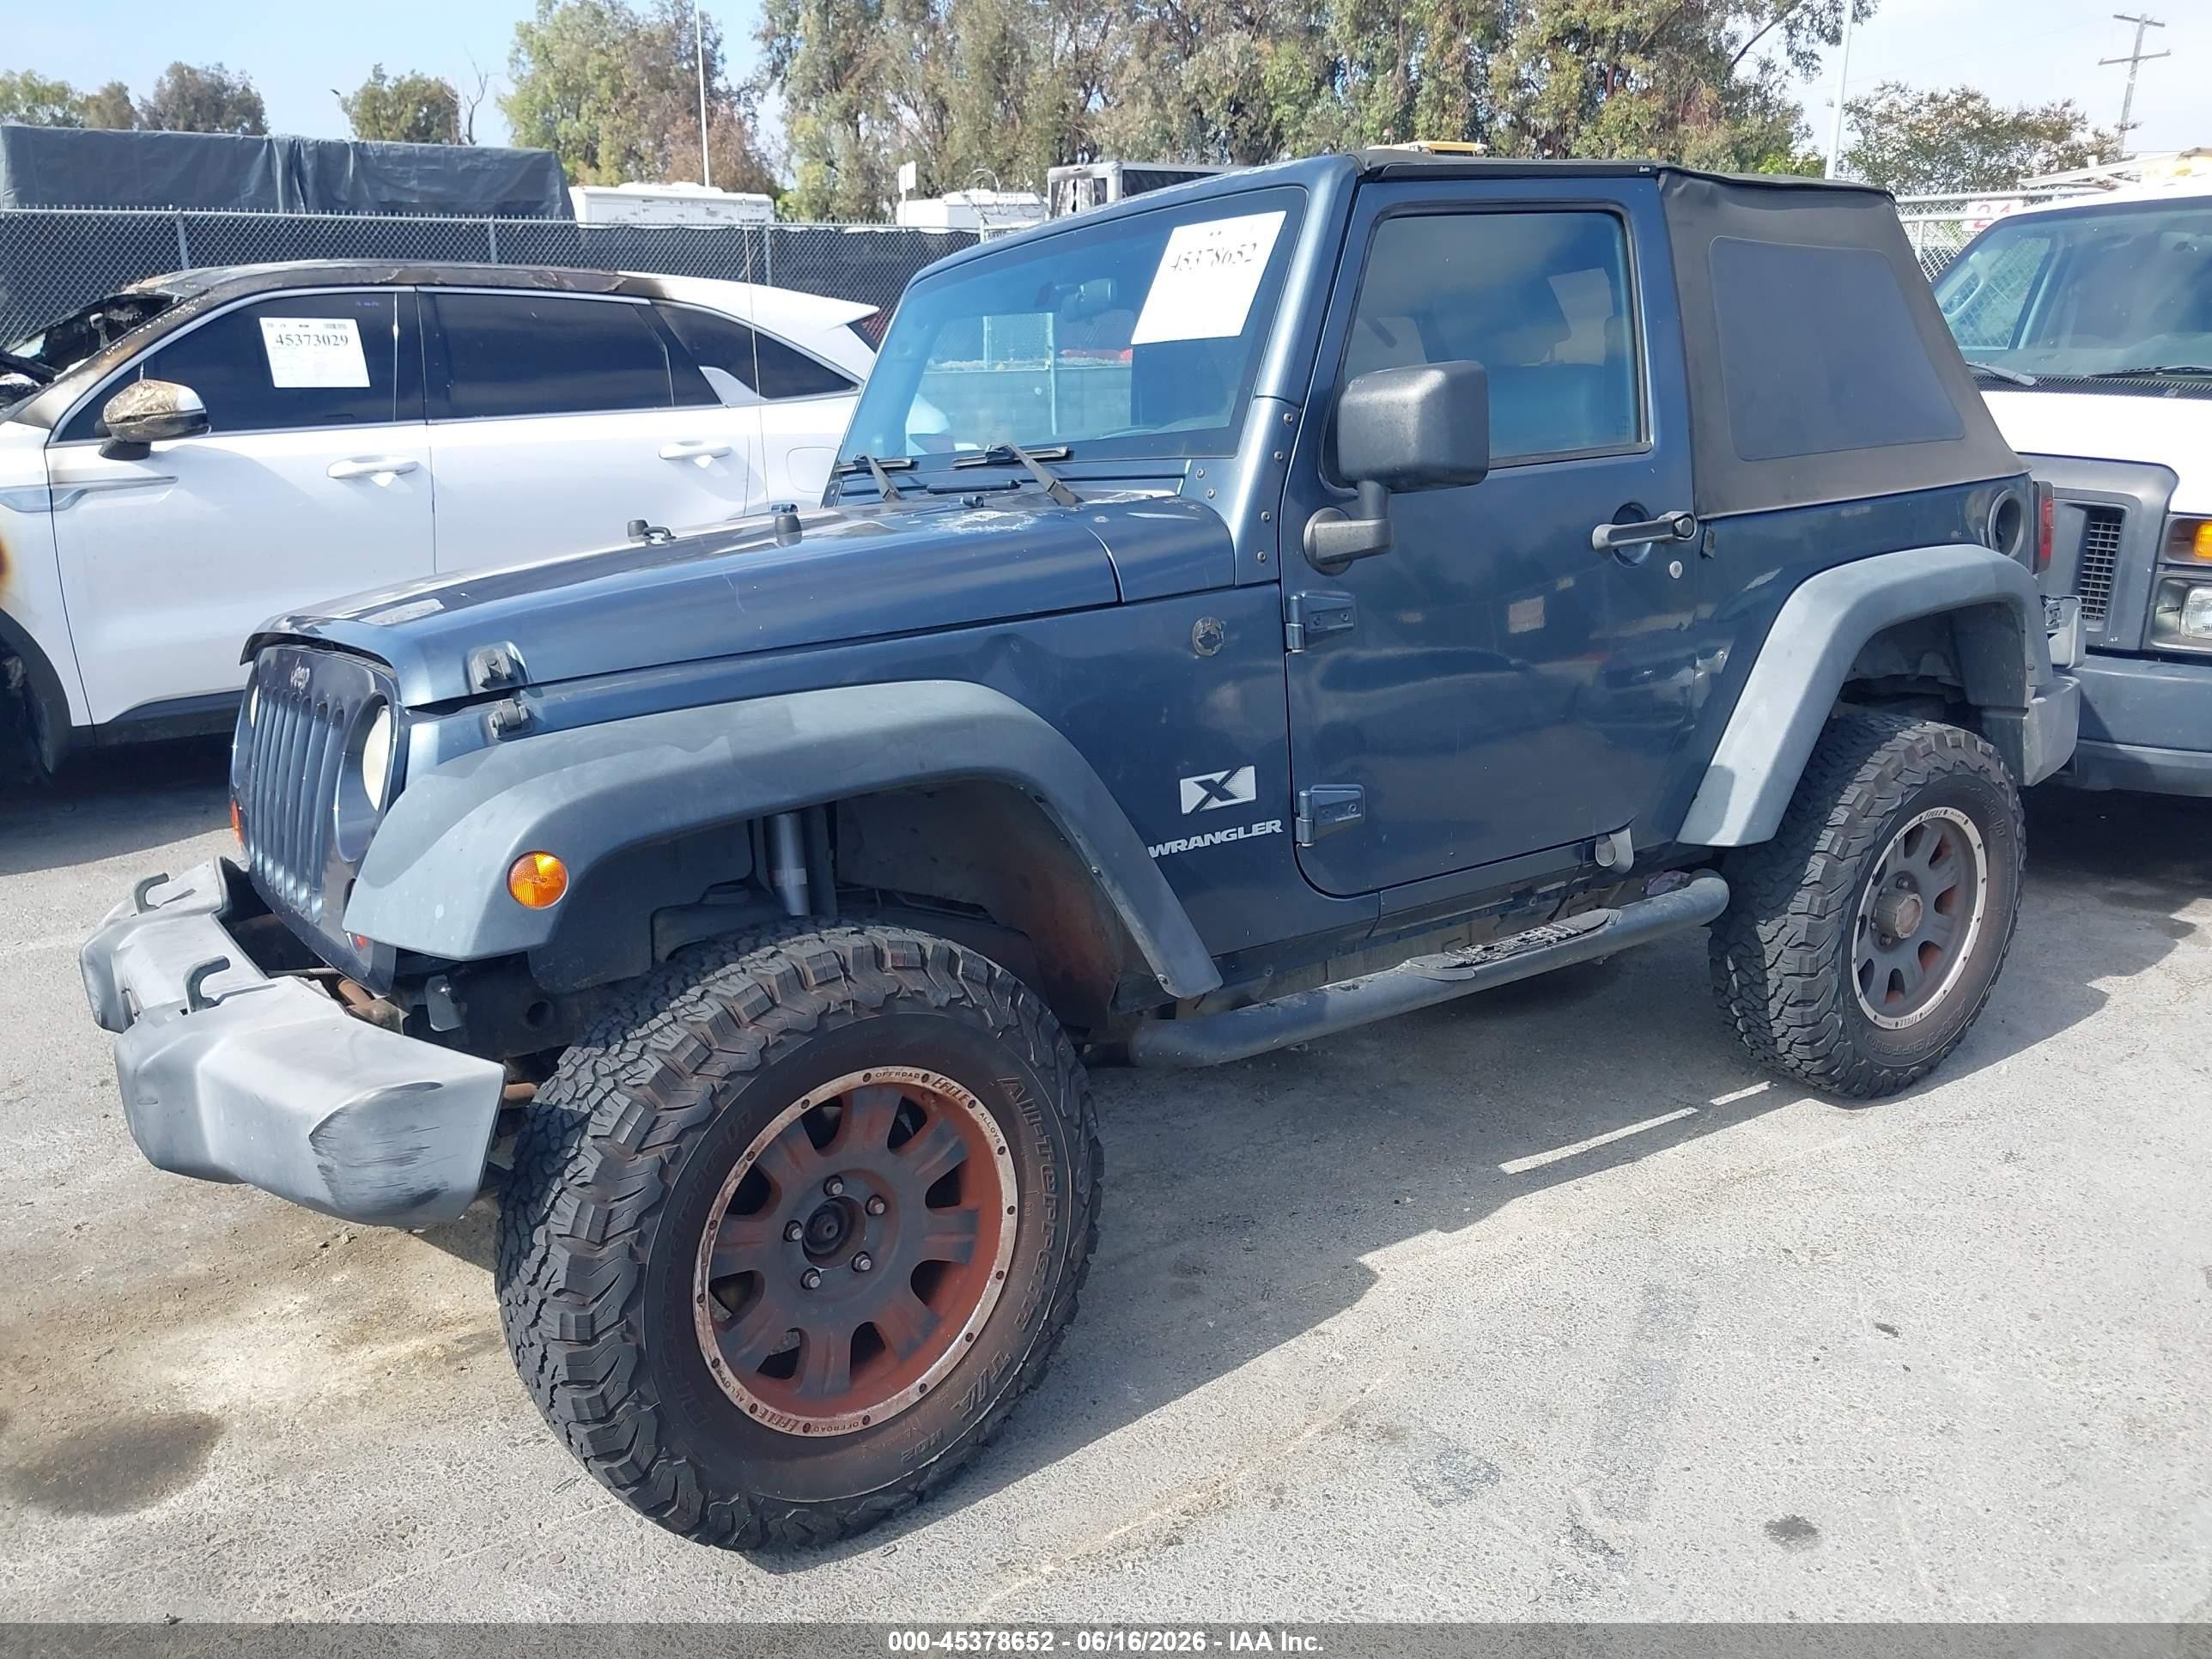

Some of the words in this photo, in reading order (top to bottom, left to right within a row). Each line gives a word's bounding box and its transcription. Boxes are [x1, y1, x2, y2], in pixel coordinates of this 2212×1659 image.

[275, 333, 349, 347] 45373029
[1183, 765, 1252, 815] X
[1147, 819, 1284, 858] WRANGLER
[875, 1071, 921, 1079] OFFROAD
[979, 1111, 1001, 1145] ALLOYS
[813, 1421, 860, 1433] OFFROAD
